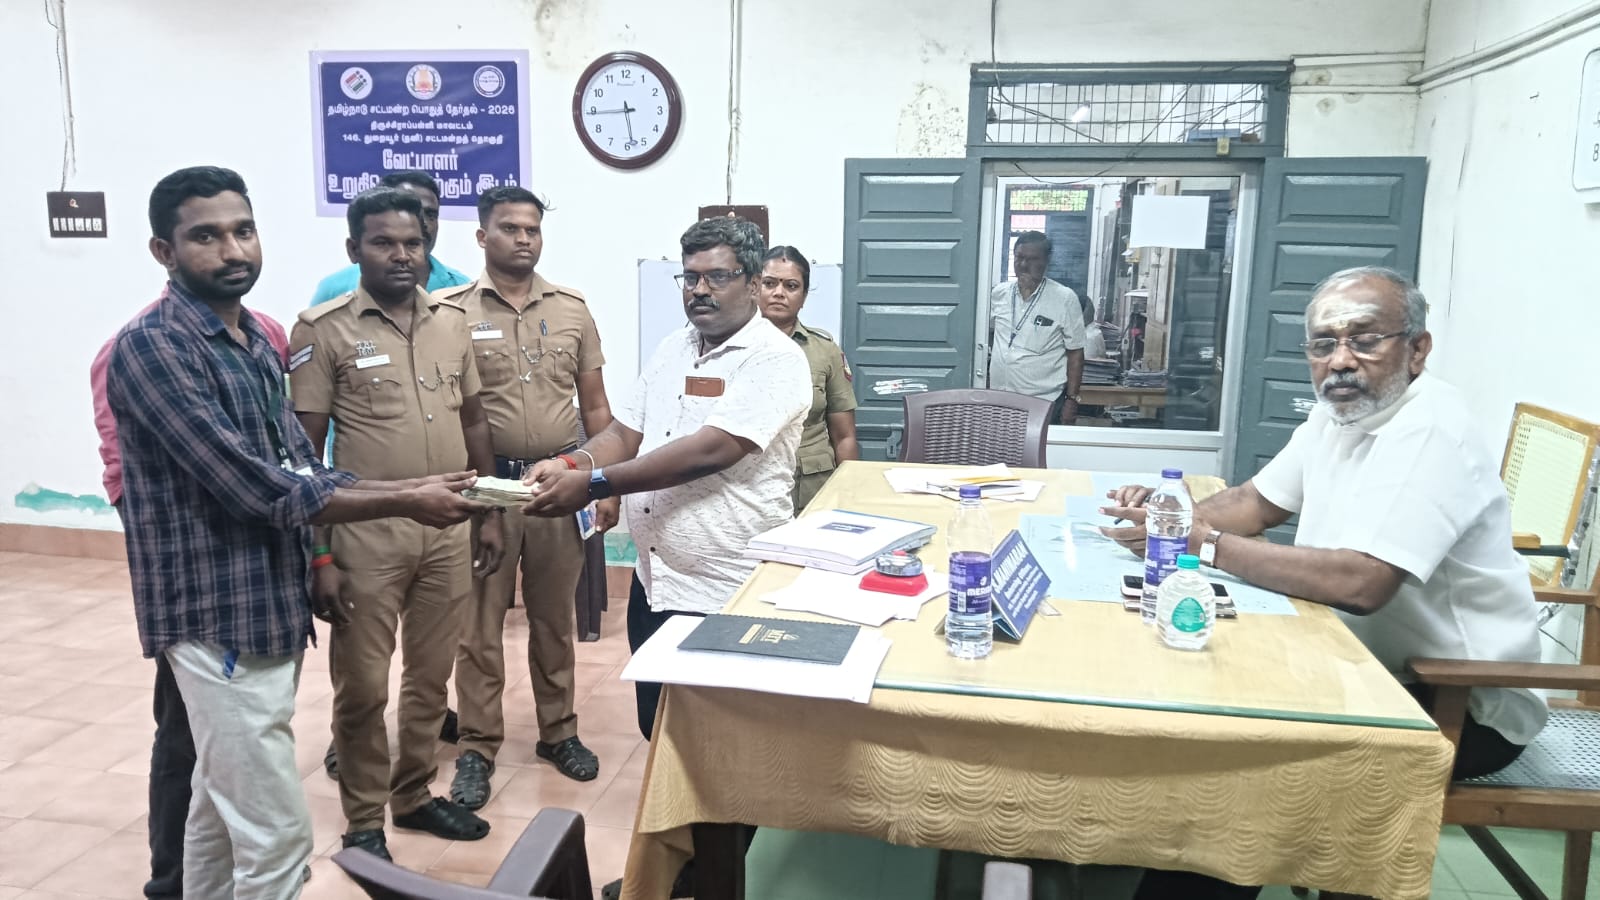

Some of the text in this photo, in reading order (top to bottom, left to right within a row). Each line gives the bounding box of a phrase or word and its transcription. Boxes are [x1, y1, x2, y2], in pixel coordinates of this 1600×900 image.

[606, 75, 613, 83] 11
[621, 70, 631, 79] 12
[595, 89, 603, 97] 10
[652, 88, 658, 96] 2
[328, 103, 368, 117] தமிழ்நாடு
[370, 104, 409, 117] சட்டமன்ற
[446, 102, 478, 117] தேர்தல்
[591, 106, 597, 115] 9
[657, 106, 663, 115] 3
[595, 124, 602, 133] 8
[653, 124, 659, 133] 4
[608, 137, 613, 146] 7
[641, 137, 646, 146] 5
[625, 142, 630, 151] 6
[382, 148, 458, 171] வேட்பாளர்
